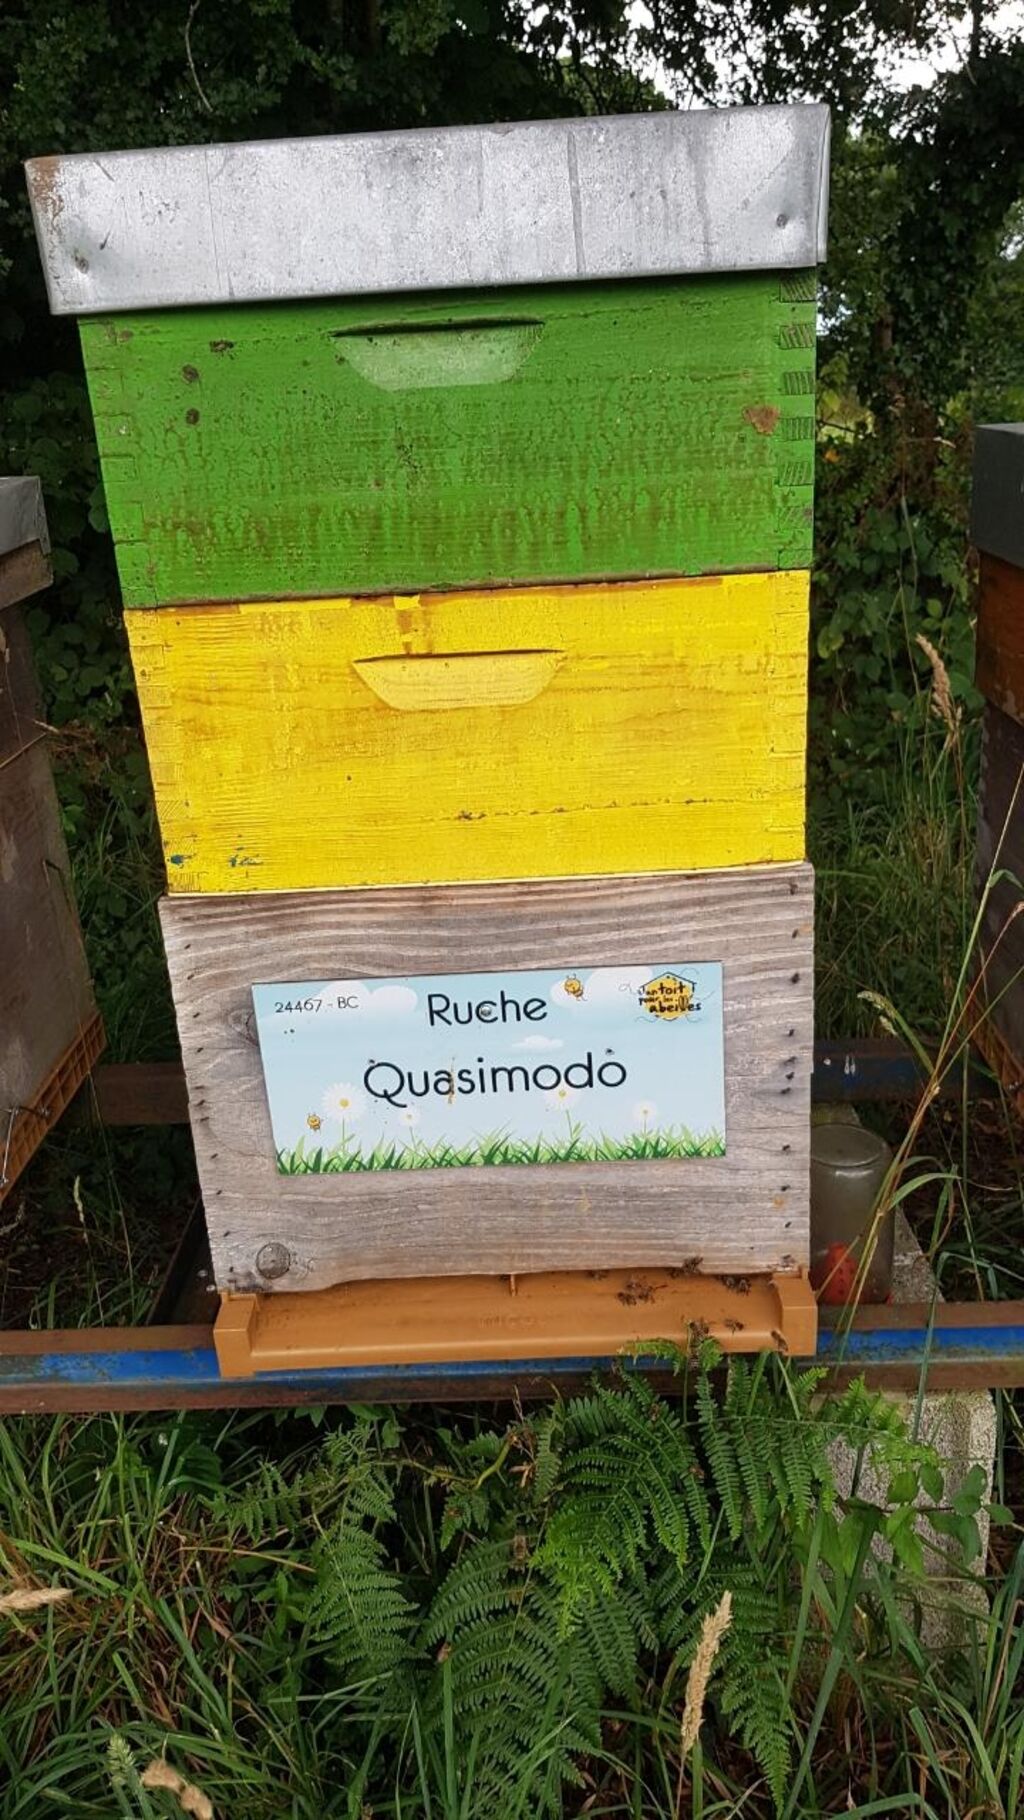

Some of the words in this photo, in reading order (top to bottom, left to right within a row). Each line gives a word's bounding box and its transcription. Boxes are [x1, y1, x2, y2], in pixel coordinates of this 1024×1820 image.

[658, 981, 685, 995] toit
[274, 998, 322, 1013] 24467
[337, 996, 360, 1009] BC
[427, 990, 548, 1026] Ruche
[649, 996, 702, 1014] abeilles
[363, 1052, 628, 1108] Quasimodo
